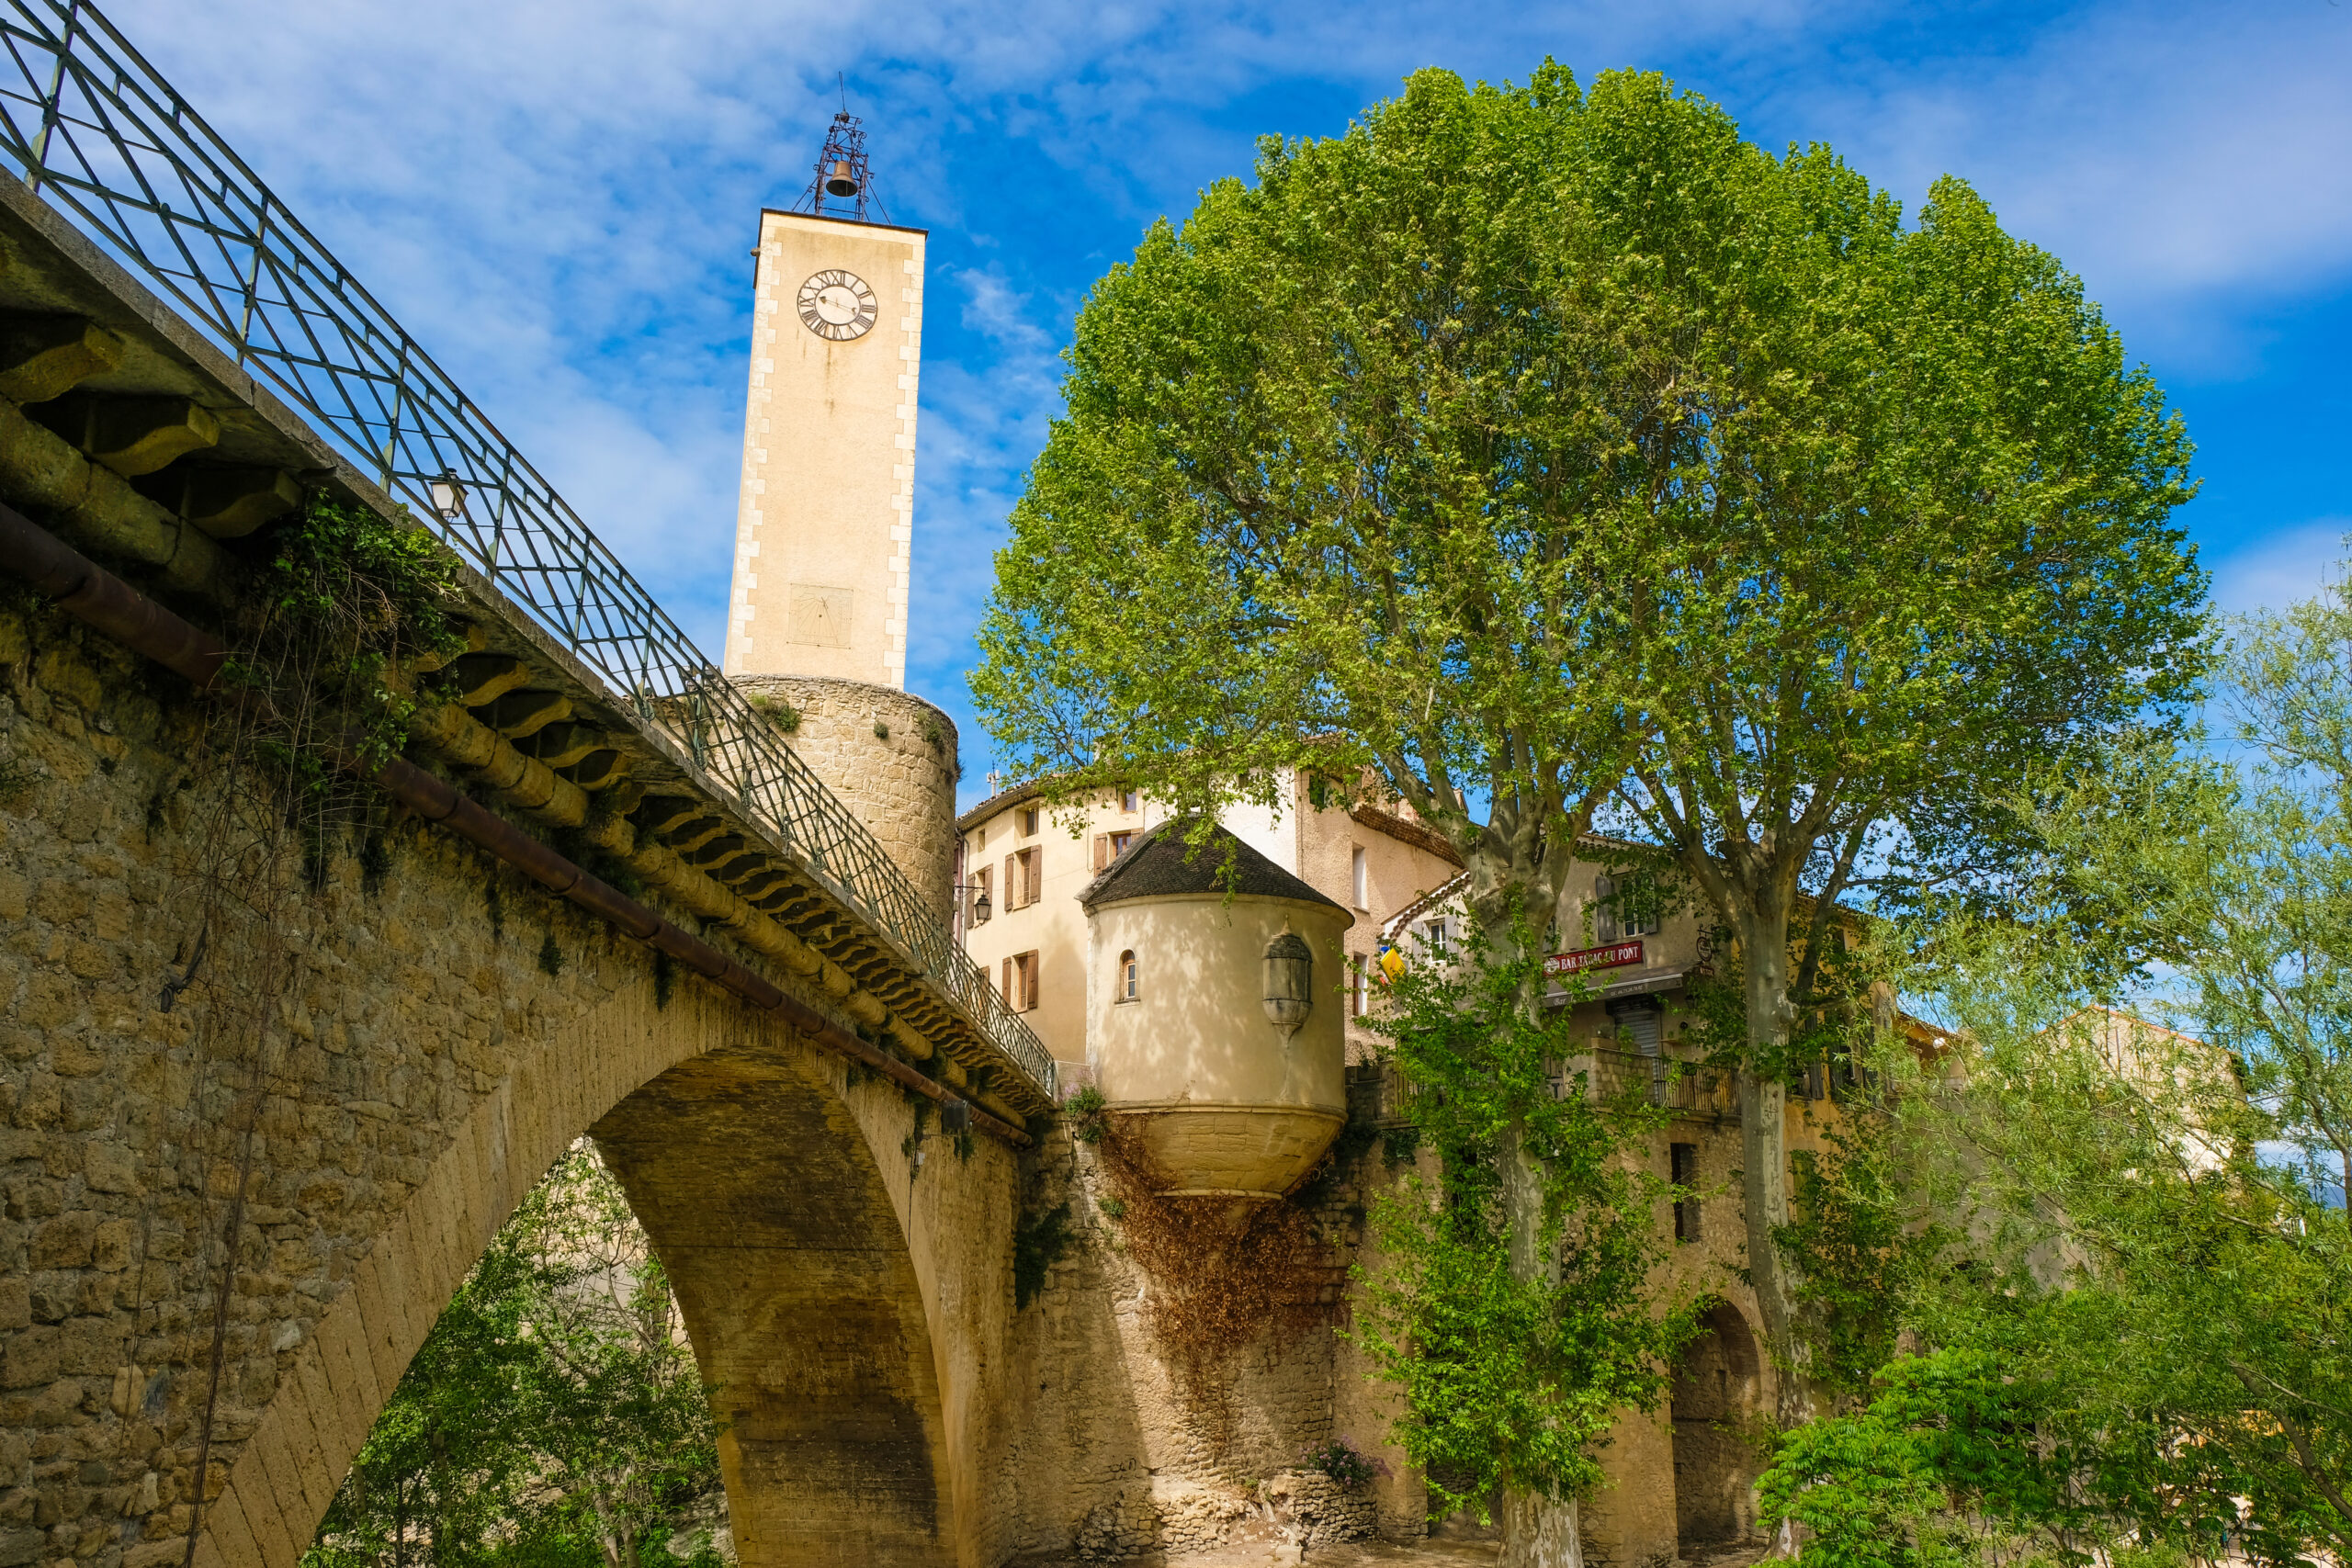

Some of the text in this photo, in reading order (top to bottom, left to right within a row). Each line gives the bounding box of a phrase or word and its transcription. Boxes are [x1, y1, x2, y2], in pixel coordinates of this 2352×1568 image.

[830, 271, 845, 286] XII
[804, 280, 820, 295] X
[861, 304, 876, 313] III
[1561, 957, 1577, 970] BAR
[1618, 946, 1639, 961] PONT
[1553, 998, 1566, 1006] Bar
